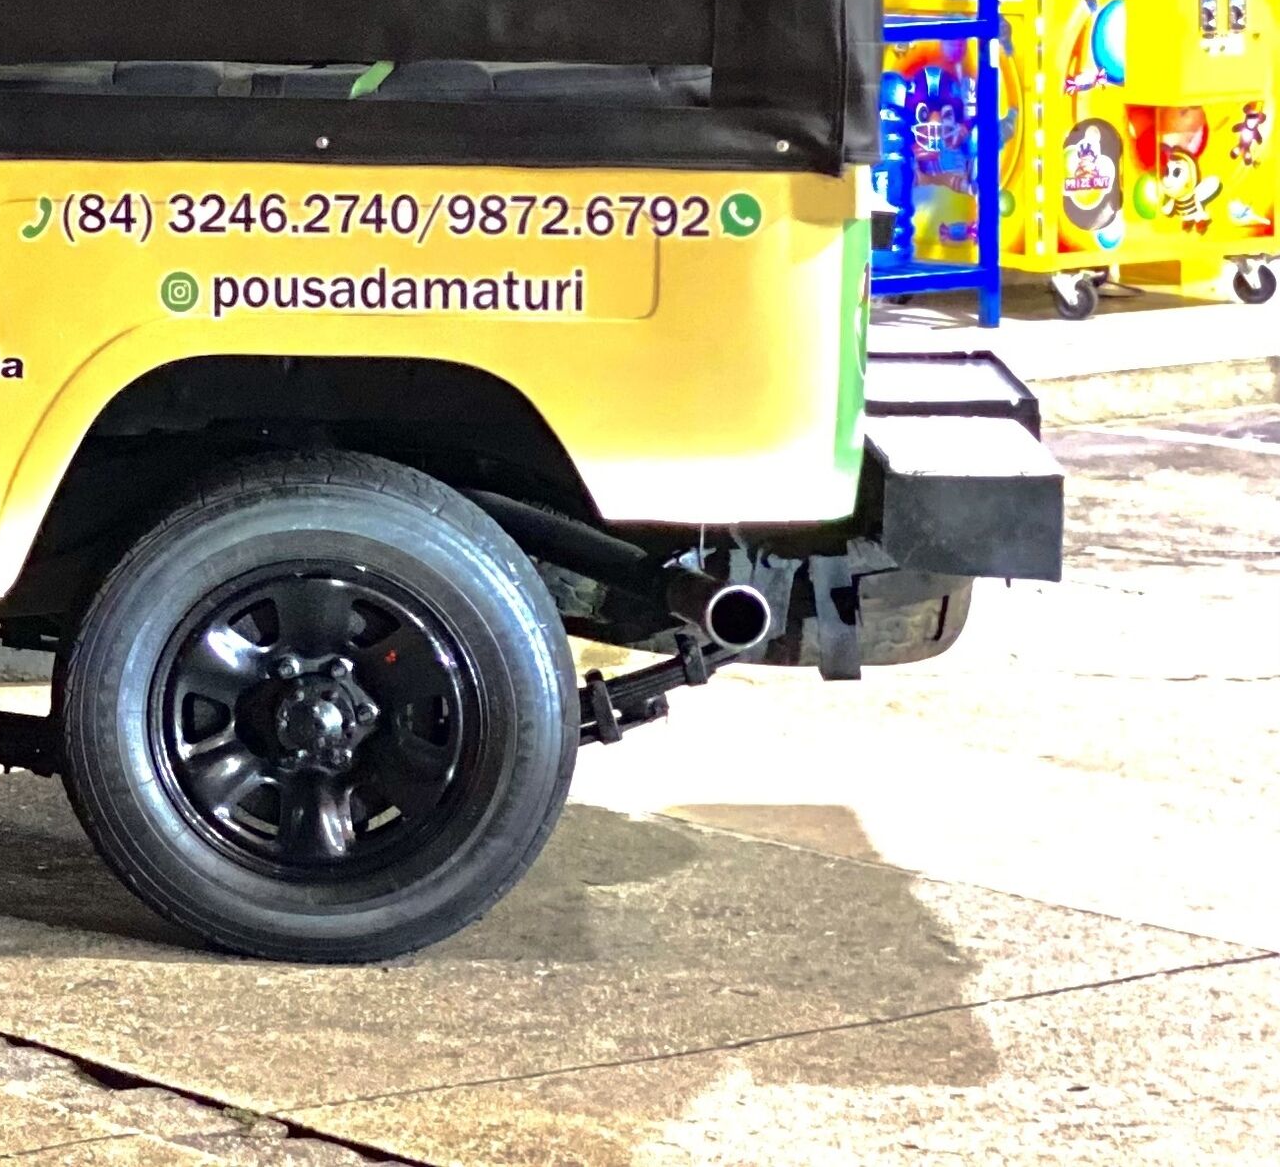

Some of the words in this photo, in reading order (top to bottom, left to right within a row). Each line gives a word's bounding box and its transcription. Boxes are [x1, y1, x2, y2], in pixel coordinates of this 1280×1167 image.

[62, 193, 153, 242] (84)
[168, 193, 710, 243] 3246.2740/9872.6792
[213, 267, 584, 317] pousadamaturi
